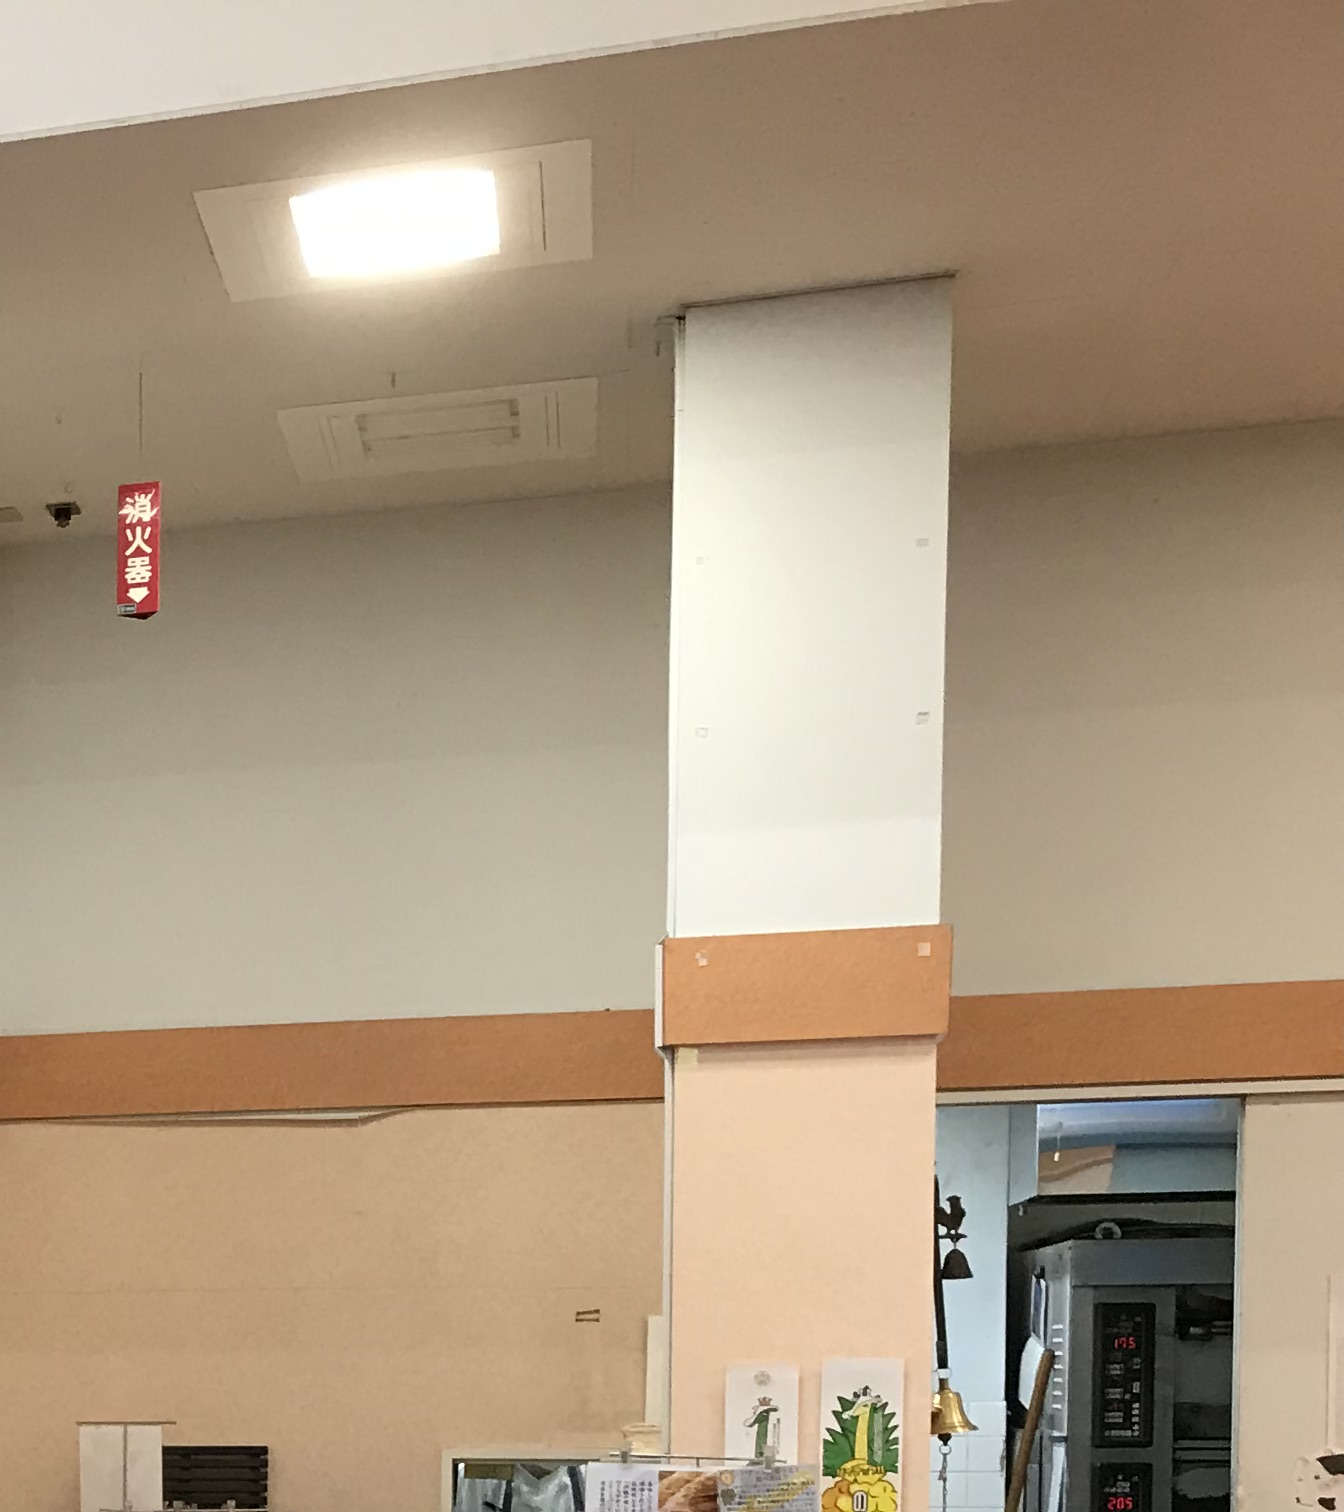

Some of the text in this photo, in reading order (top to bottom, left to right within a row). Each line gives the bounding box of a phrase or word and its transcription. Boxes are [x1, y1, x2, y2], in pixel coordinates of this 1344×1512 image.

[119, 488, 159, 584] 消火器
[1107, 1497, 1133, 1510] 205
